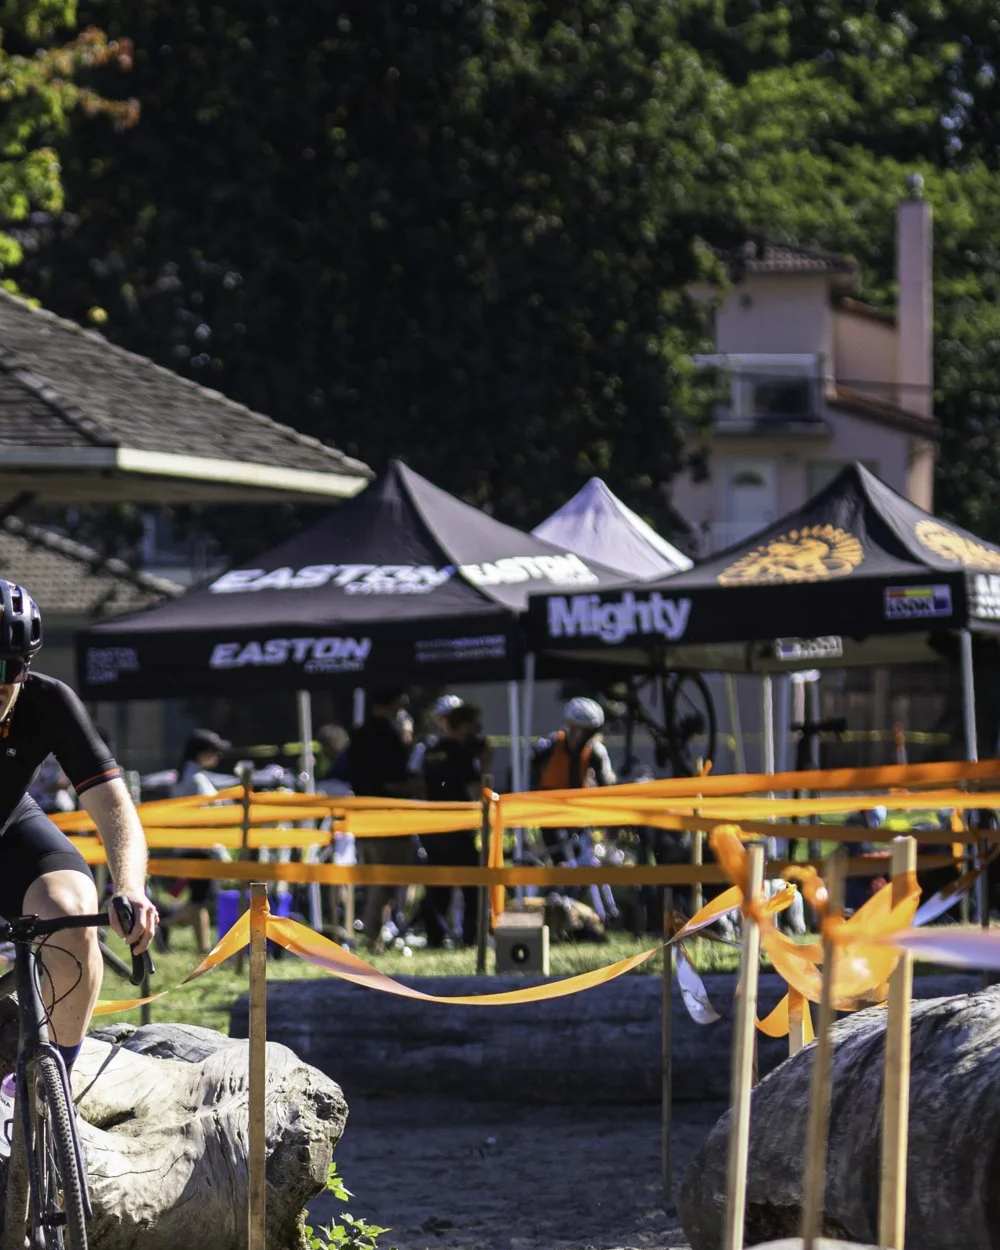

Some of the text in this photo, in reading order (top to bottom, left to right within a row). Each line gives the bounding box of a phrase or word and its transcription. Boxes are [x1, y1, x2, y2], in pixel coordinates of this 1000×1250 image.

[209, 564, 456, 593] EASTON
[548, 591, 691, 643] Mighty
[210, 637, 372, 668] EASTON
